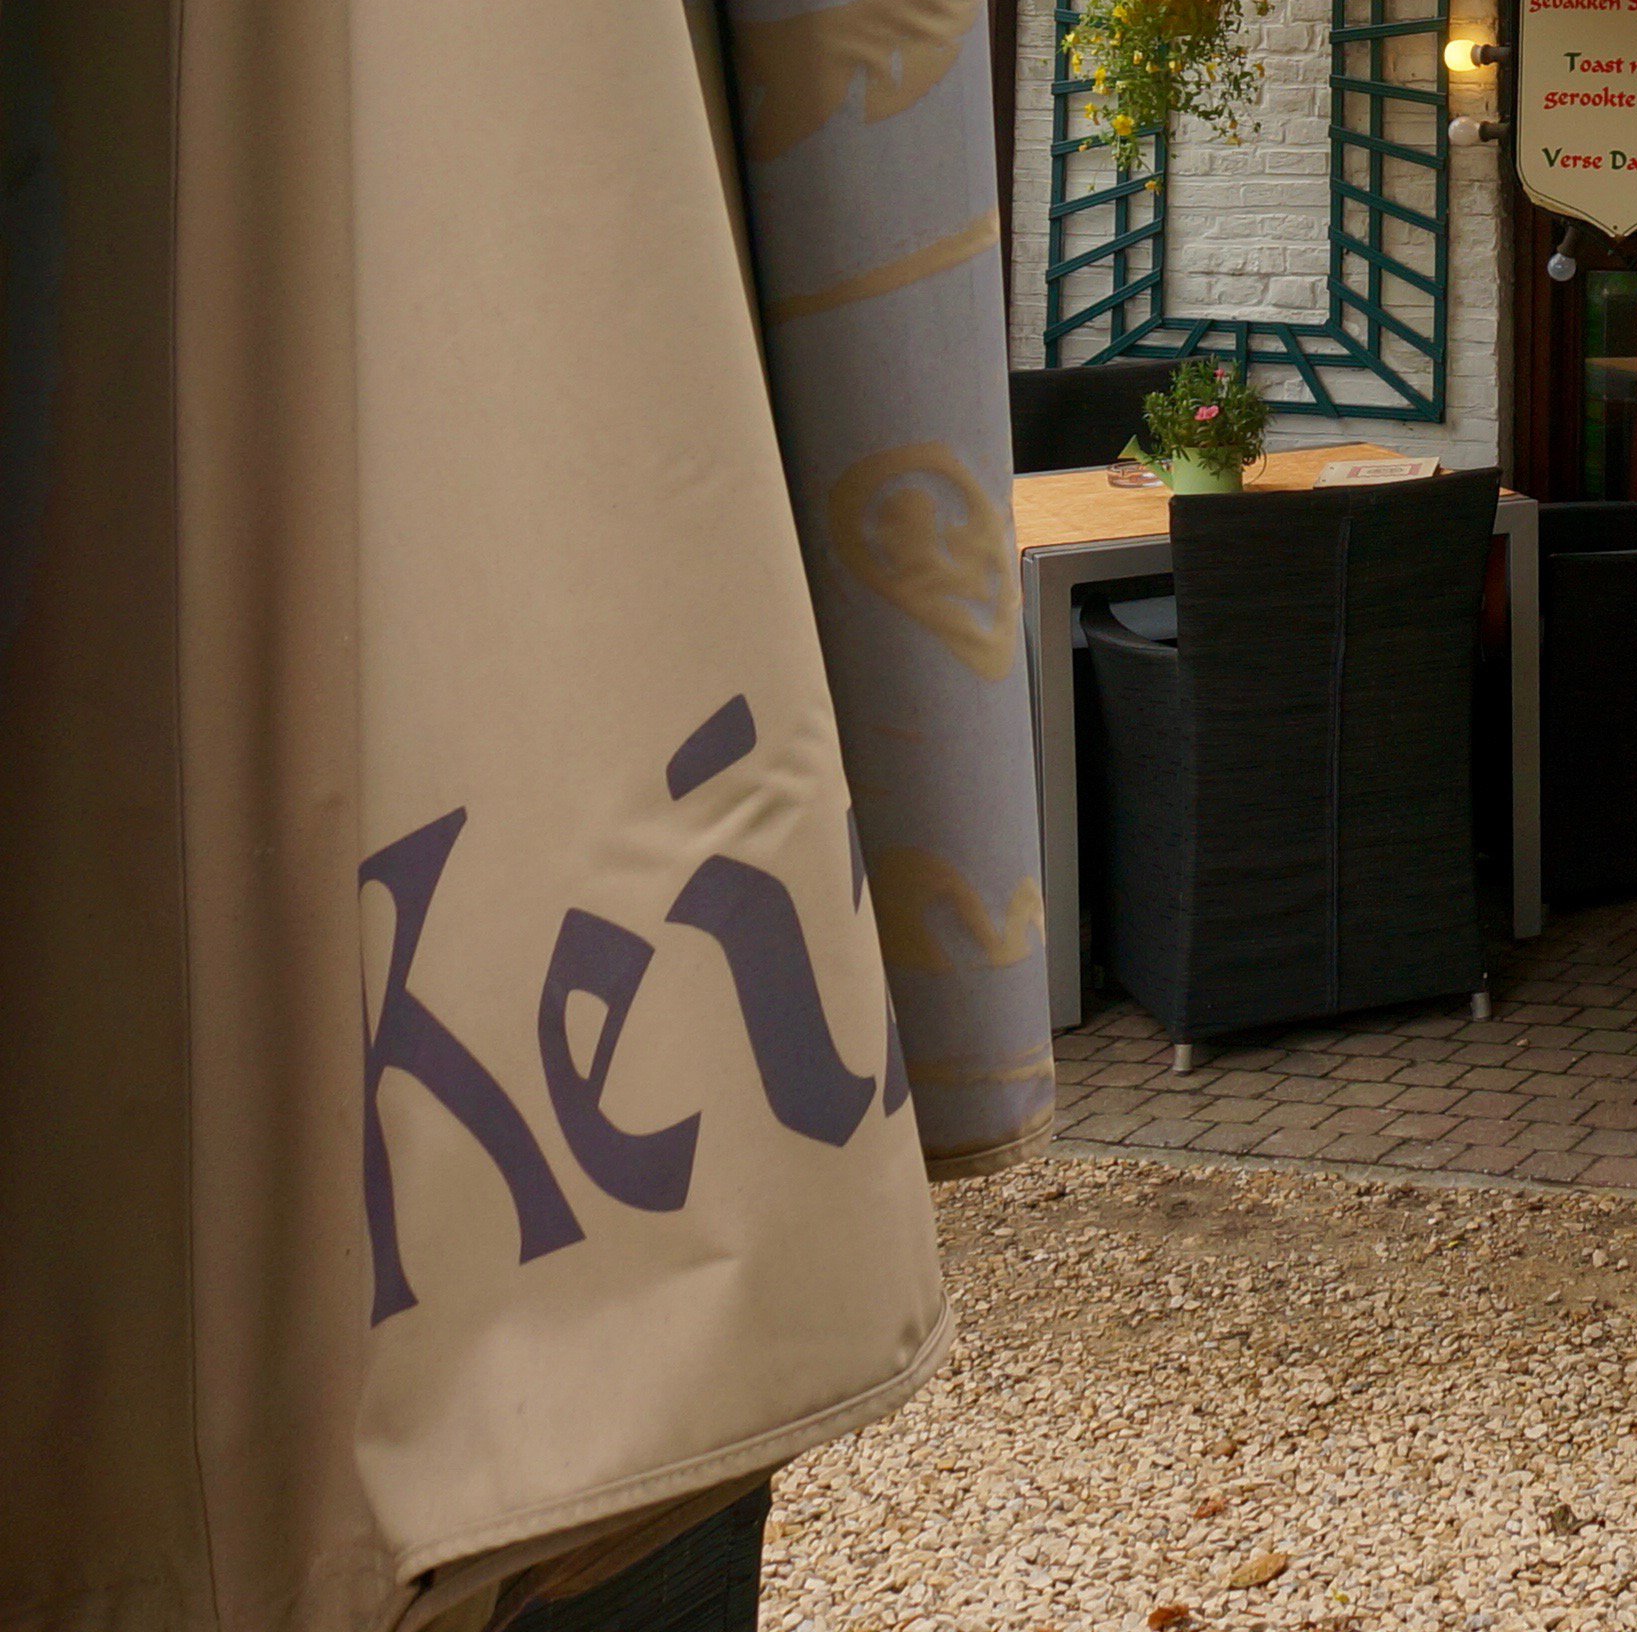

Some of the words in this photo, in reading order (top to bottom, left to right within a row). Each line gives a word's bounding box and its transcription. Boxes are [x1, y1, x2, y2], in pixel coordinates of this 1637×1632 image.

[1564, 52, 1624, 74] Toast
[1543, 88, 1636, 110] gerookte
[1542, 148, 1602, 170] Verse
[358, 694, 908, 1329] Kei
